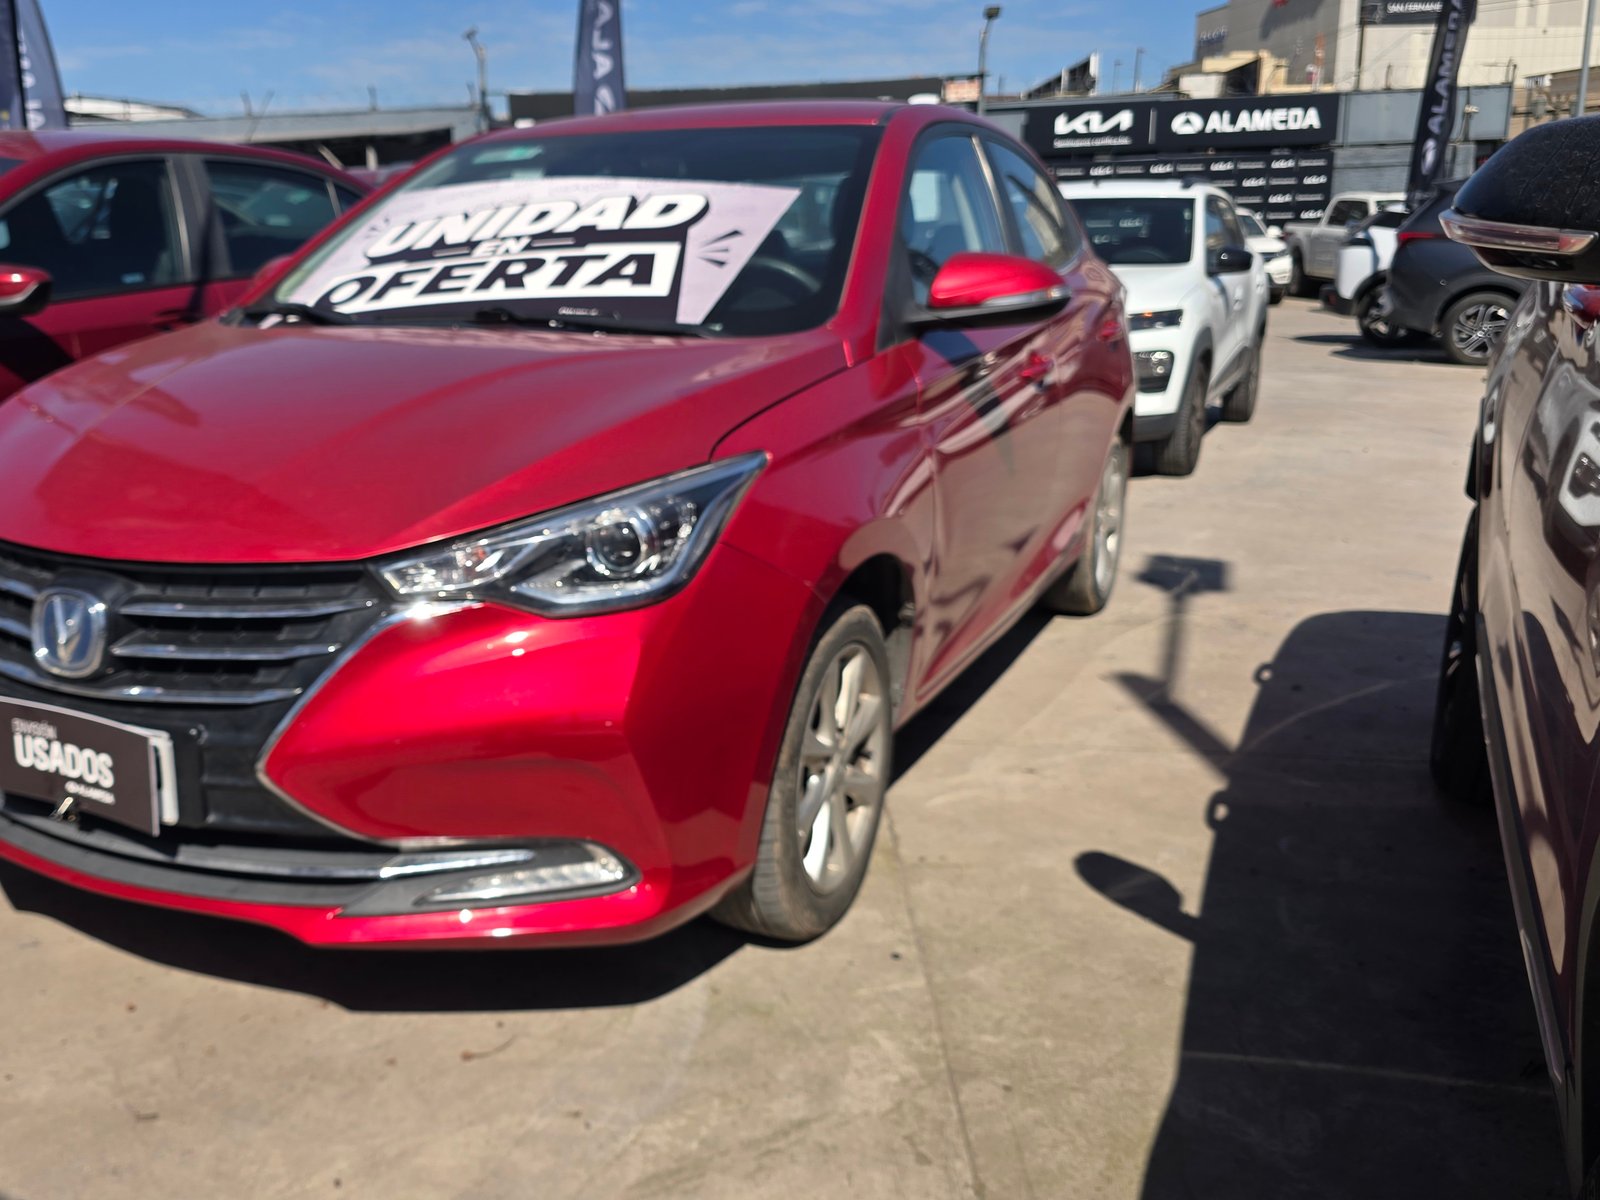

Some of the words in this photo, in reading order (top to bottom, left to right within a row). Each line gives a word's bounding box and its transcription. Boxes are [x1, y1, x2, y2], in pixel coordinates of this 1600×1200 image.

[1053, 109, 1134, 135] KIA
[1205, 107, 1322, 133] ALAMEDA
[365, 193, 708, 260] UNIDAD
[472, 236, 526, 256] EN
[318, 253, 656, 307] OFERTA
[14, 734, 115, 788] USADOS
